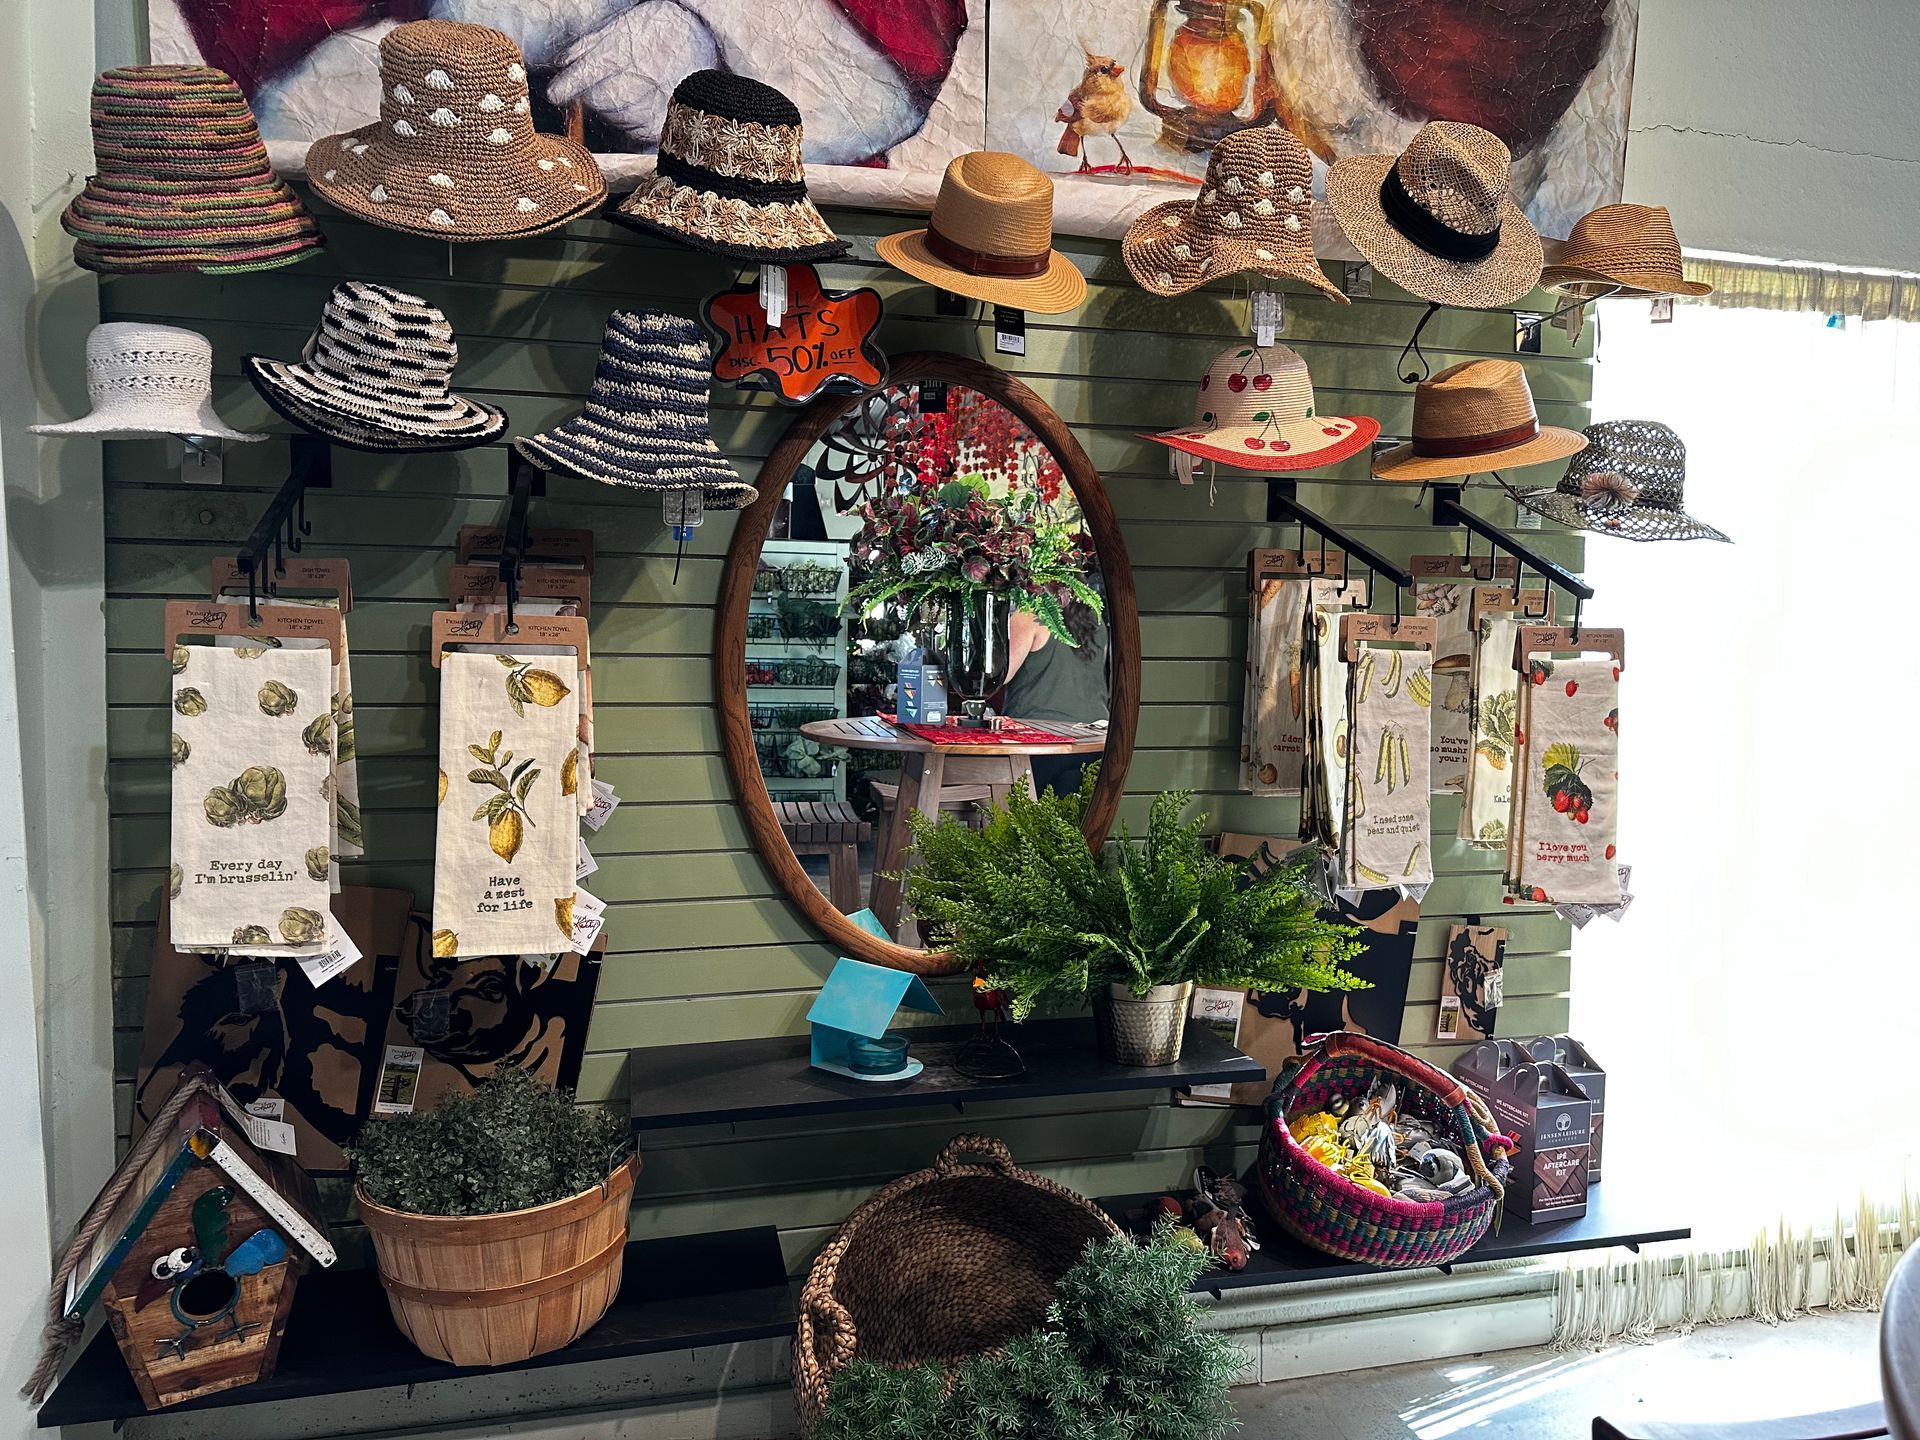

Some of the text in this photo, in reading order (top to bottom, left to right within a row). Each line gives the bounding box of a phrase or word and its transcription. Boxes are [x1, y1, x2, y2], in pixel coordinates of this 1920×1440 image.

[734, 310, 839, 344] HATS
[729, 342, 857, 376] DISC. 50% OFF
[1287, 734, 1302, 743] don
[1440, 735, 1468, 744] You've
[1272, 744, 1300, 752] carrot
[1440, 746, 1468, 754] mushr
[1439, 755, 1460, 763] your
[1378, 814, 1397, 824] need
[1397, 813, 1414, 823] some
[1386, 825, 1399, 834] and
[1400, 823, 1420, 835] quiet
[1545, 842, 1569, 851] love
[1570, 843, 1588, 852] you
[1536, 853, 1590, 864] berry much
[210, 859, 283, 873] Every day
[194, 870, 297, 884] I'm brusselin'
[488, 876, 521, 887] Have
[483, 887, 525, 899] a zest
[476, 899, 533, 912] for life
[1502, 1101, 1522, 1115] AFTERCARE
[1540, 1130, 1562, 1140] JENSEN
[1562, 1128, 1586, 1137] LEISURE
[1543, 1158, 1580, 1170] AFTERCARE
[1555, 1168, 1567, 1177] KIT
